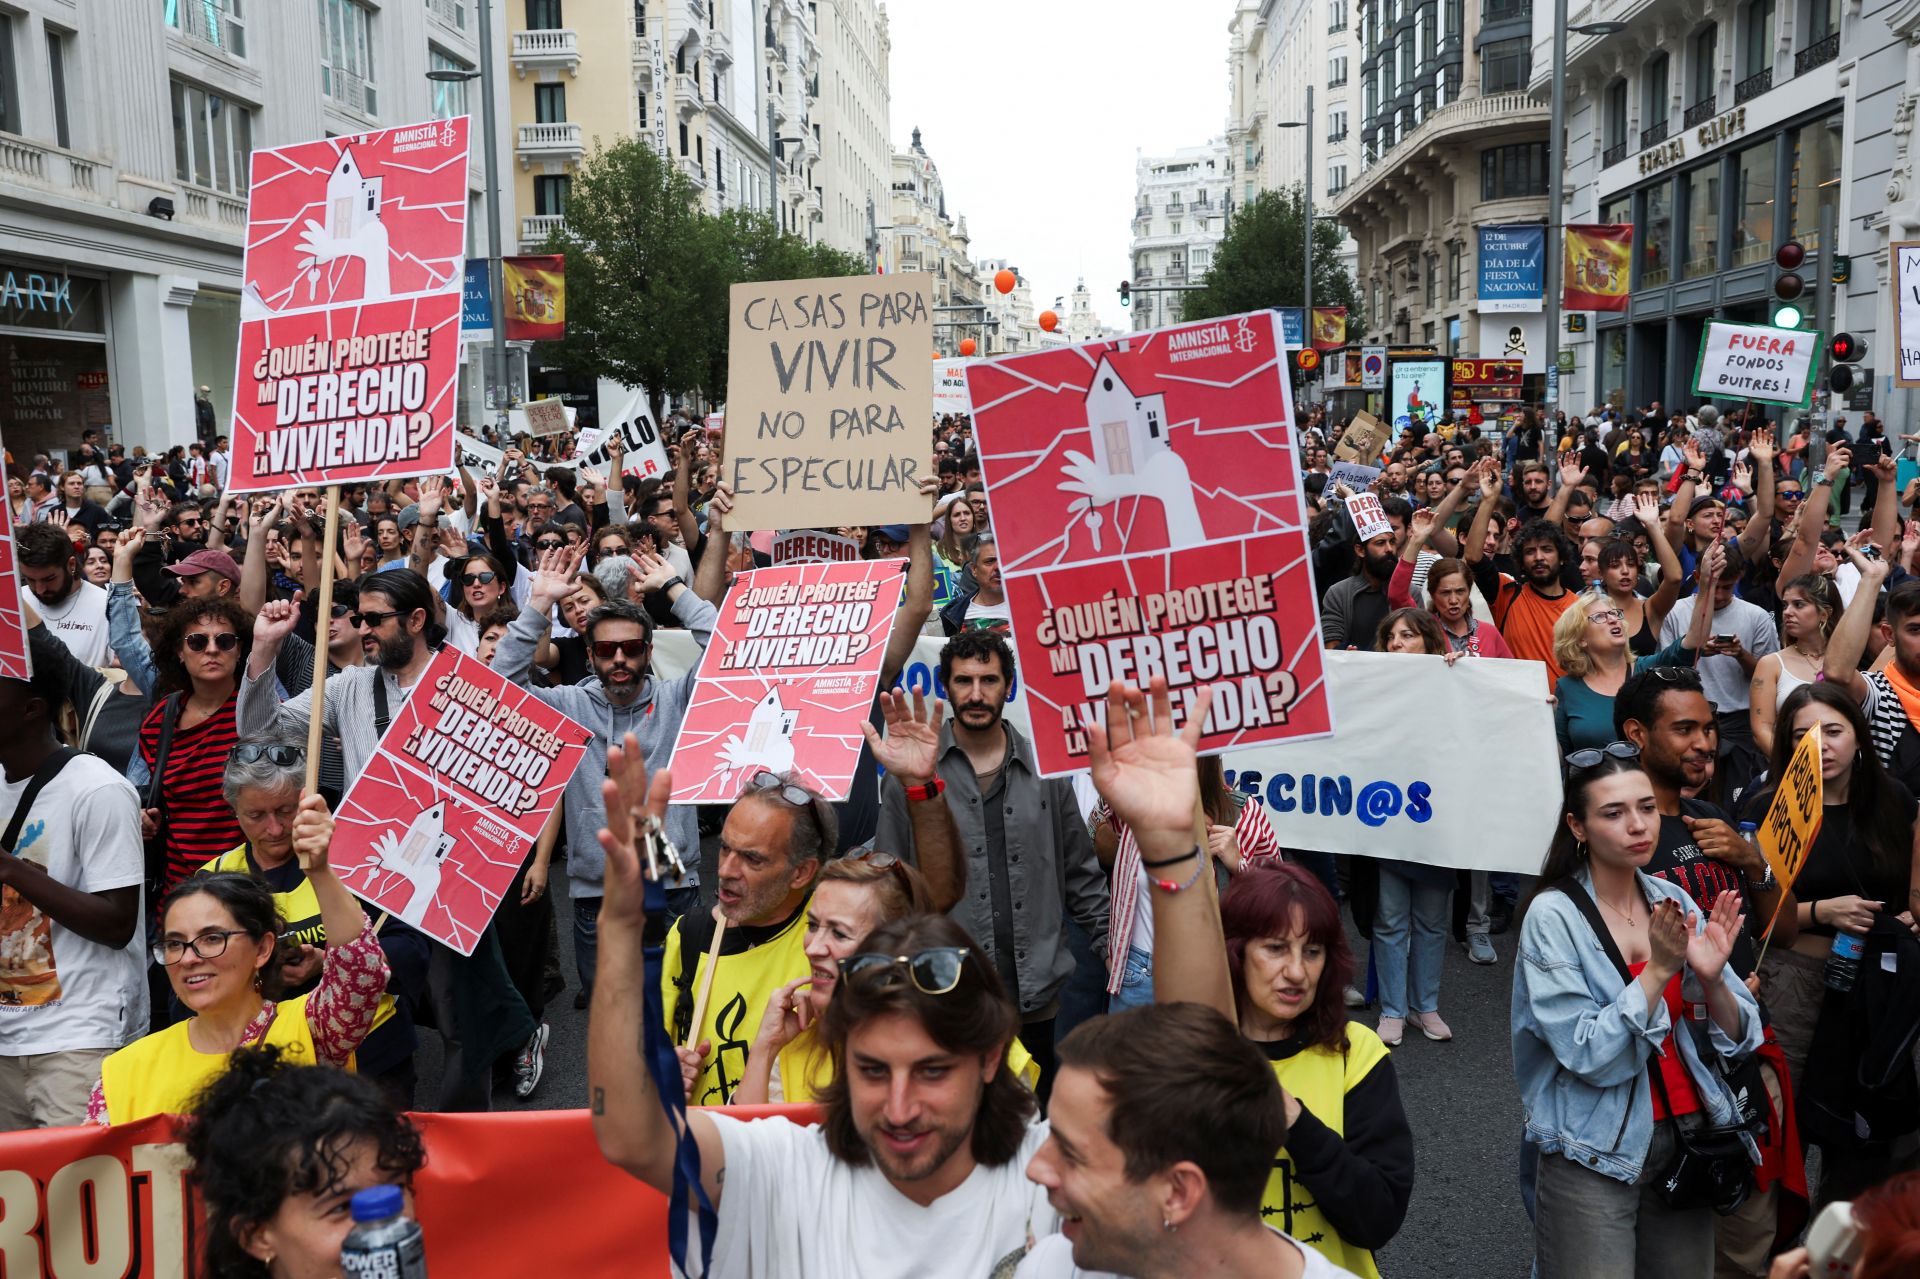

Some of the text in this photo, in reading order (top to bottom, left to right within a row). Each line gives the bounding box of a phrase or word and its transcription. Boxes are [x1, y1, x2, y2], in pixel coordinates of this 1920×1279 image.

[656, 81, 662, 100] IS
[656, 105, 663, 114] A
[392, 139, 438, 154] INTERNACIONAL
[393, 124, 438, 145] AMNISTÍA
[1484, 233, 1507, 241] 12 DE
[1484, 242, 1528, 251] OCTUBRE
[1484, 258, 1536, 268] DÍA DE LA
[1484, 271, 1520, 280] FIESTA
[1484, 282, 1539, 292] NACIONAL
[744, 291, 928, 331] CASAS PARA
[1168, 323, 1230, 351] AMNISTÍA
[1727, 333, 1796, 356] FUERA
[253, 327, 430, 381] ¿QUIÉN PROTEGE
[770, 336, 906, 394] VIVIR
[1169, 342, 1233, 364] INTERNACIONAL
[1726, 355, 1784, 371] FONDOS
[257, 362, 428, 427] MI DERECHO
[1718, 373, 1780, 392] BUITRES
[757, 403, 905, 442] NO PARA
[253, 455, 269, 477] LA
[269, 411, 433, 474] VIVIENDA?
[255, 431, 268, 454] A
[733, 453, 925, 495] ESPECULAR
[1355, 514, 1367, 529] A
[773, 535, 857, 564] DERECHO
[735, 580, 879, 609] ¿QUIÉN PROTEGE
[734, 602, 873, 639] MI DERECHO
[1036, 573, 1275, 647] ¿QUIÉN PROTEGE
[719, 633, 870, 670] LA VIVIENDA?
[724, 640, 735, 656] A
[1050, 644, 1078, 674] MI
[1076, 614, 1281, 699] DERECHO
[811, 687, 850, 695] INTERNACIONAL
[813, 677, 852, 689] AMNISTÍA
[434, 671, 565, 760] ¿QUIÉN PROTEGE
[1062, 705, 1077, 730] A
[410, 723, 422, 739] A
[428, 691, 551, 788] MI DERECHO
[1065, 732, 1089, 756] LA
[402, 728, 540, 819] LA VIVIENDA?
[472, 825, 506, 849] INTERNACIONAL
[476, 816, 511, 841] AMNISTÍA
